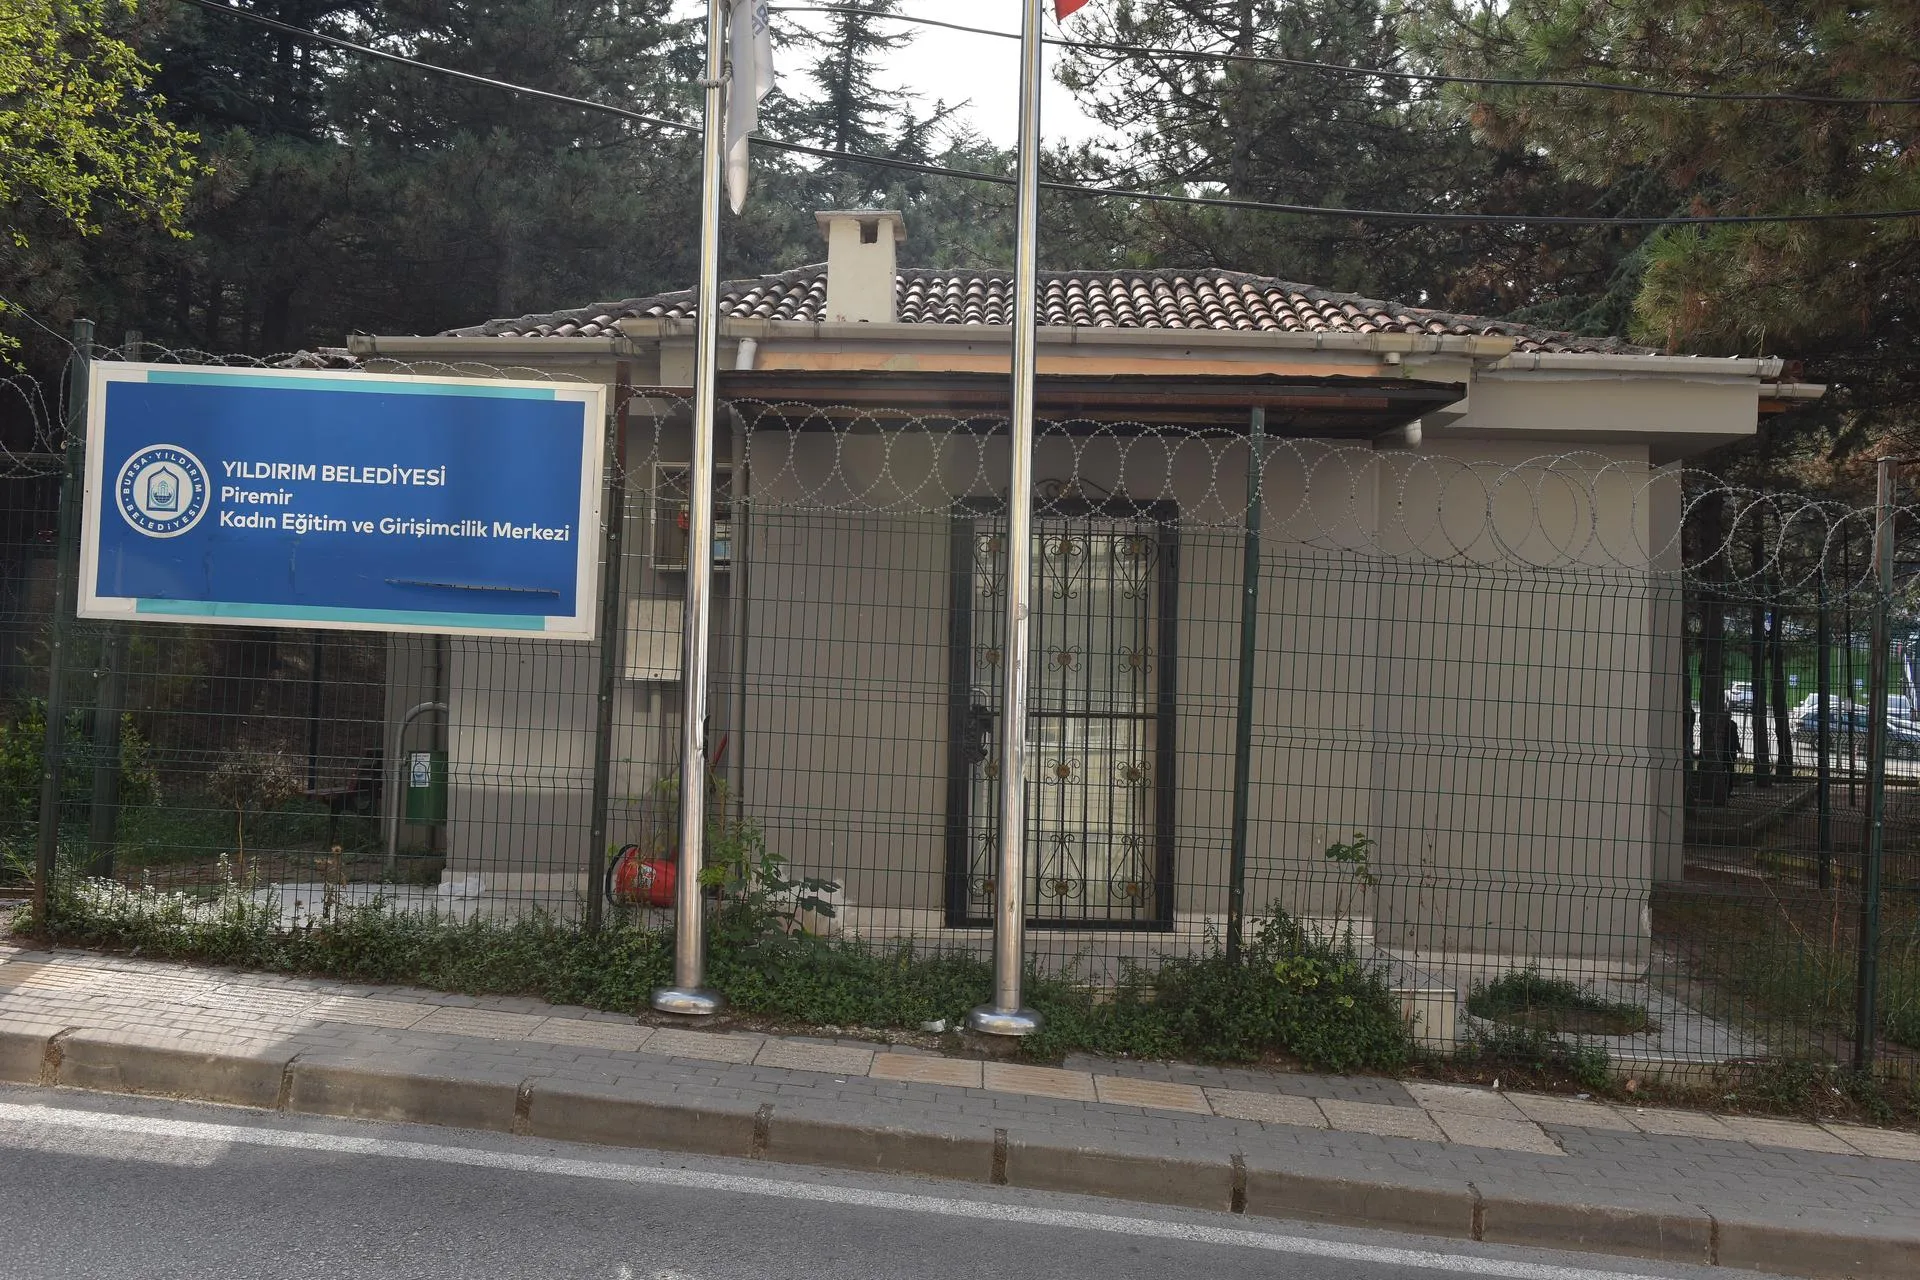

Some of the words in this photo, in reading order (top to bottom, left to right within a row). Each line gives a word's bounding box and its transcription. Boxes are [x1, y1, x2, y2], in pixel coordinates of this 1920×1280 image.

[122, 457, 149, 494] BURSA
[154, 452, 203, 493] YILDIRIM
[221, 460, 316, 481] YILDIRIM
[321, 463, 447, 486] BELEDİYESİ
[221, 486, 294, 505] Piremir
[220, 510, 277, 530] Kadın
[281, 512, 347, 537] Eğitim
[351, 519, 375, 535] ve
[379, 517, 488, 541] Girişimcilik
[493, 521, 571, 543] Merkezi
